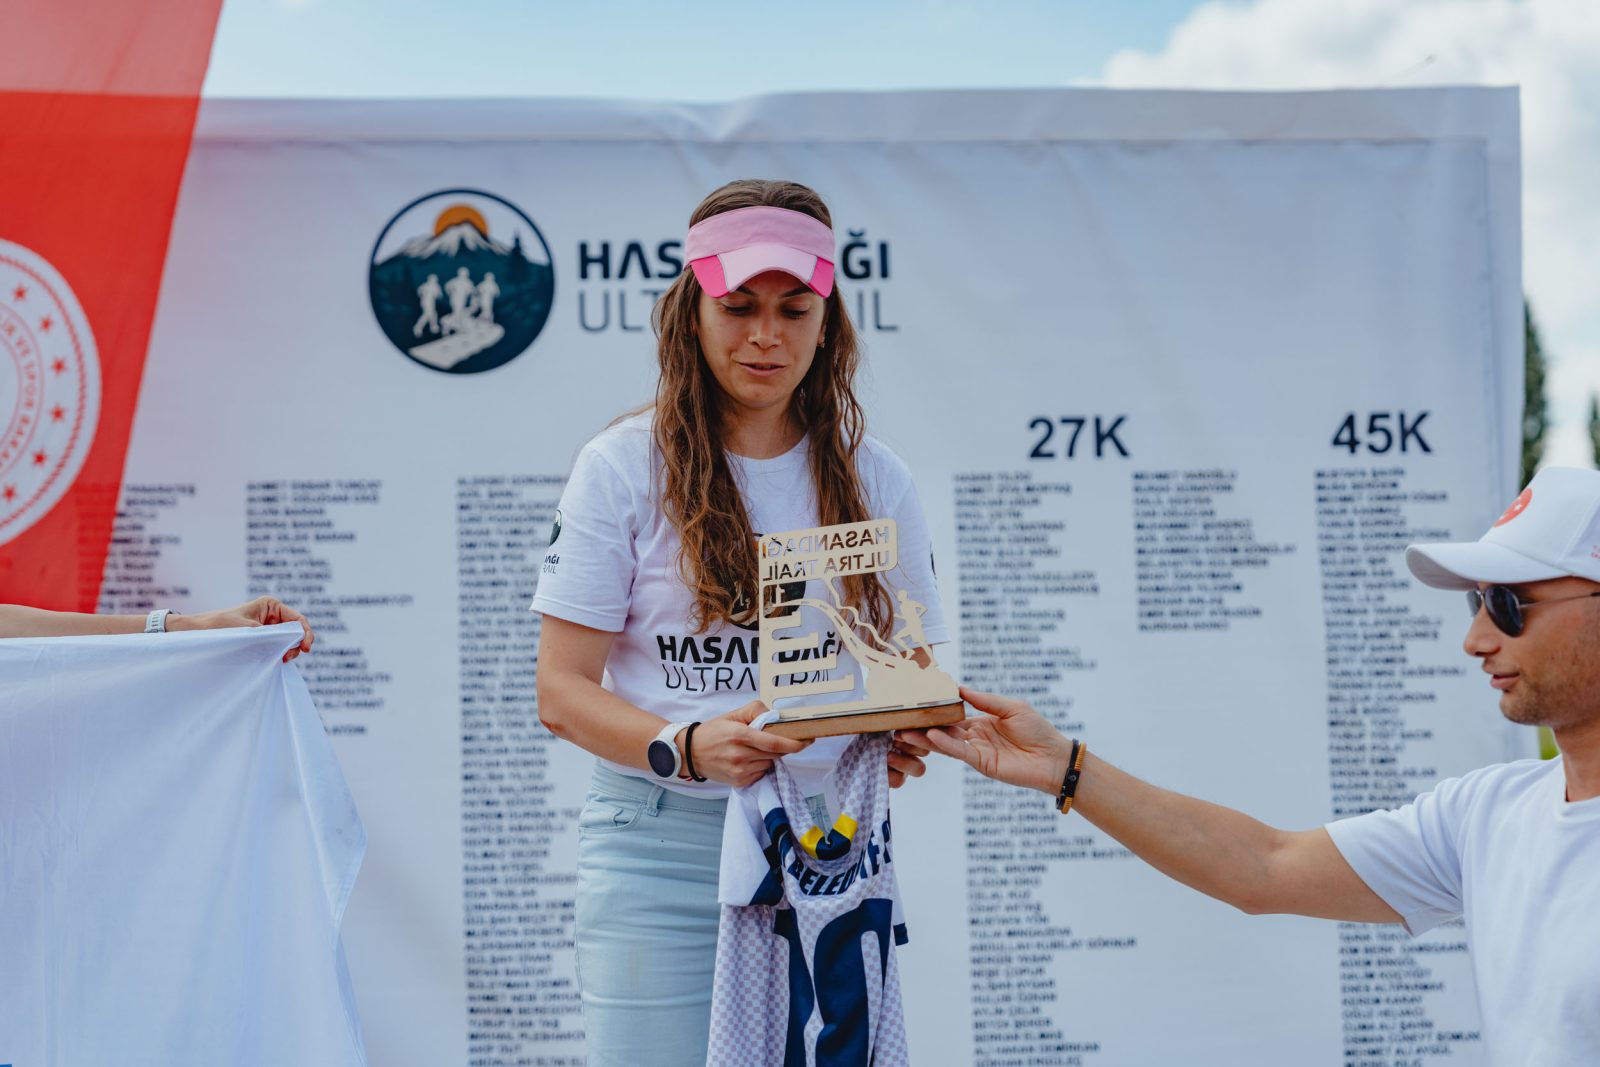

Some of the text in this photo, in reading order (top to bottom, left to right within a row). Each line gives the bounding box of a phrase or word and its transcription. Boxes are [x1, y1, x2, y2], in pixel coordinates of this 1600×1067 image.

[1028, 413, 1131, 459] 27K
[1331, 411, 1433, 455] 45K
[662, 663, 757, 692] ULTRA
